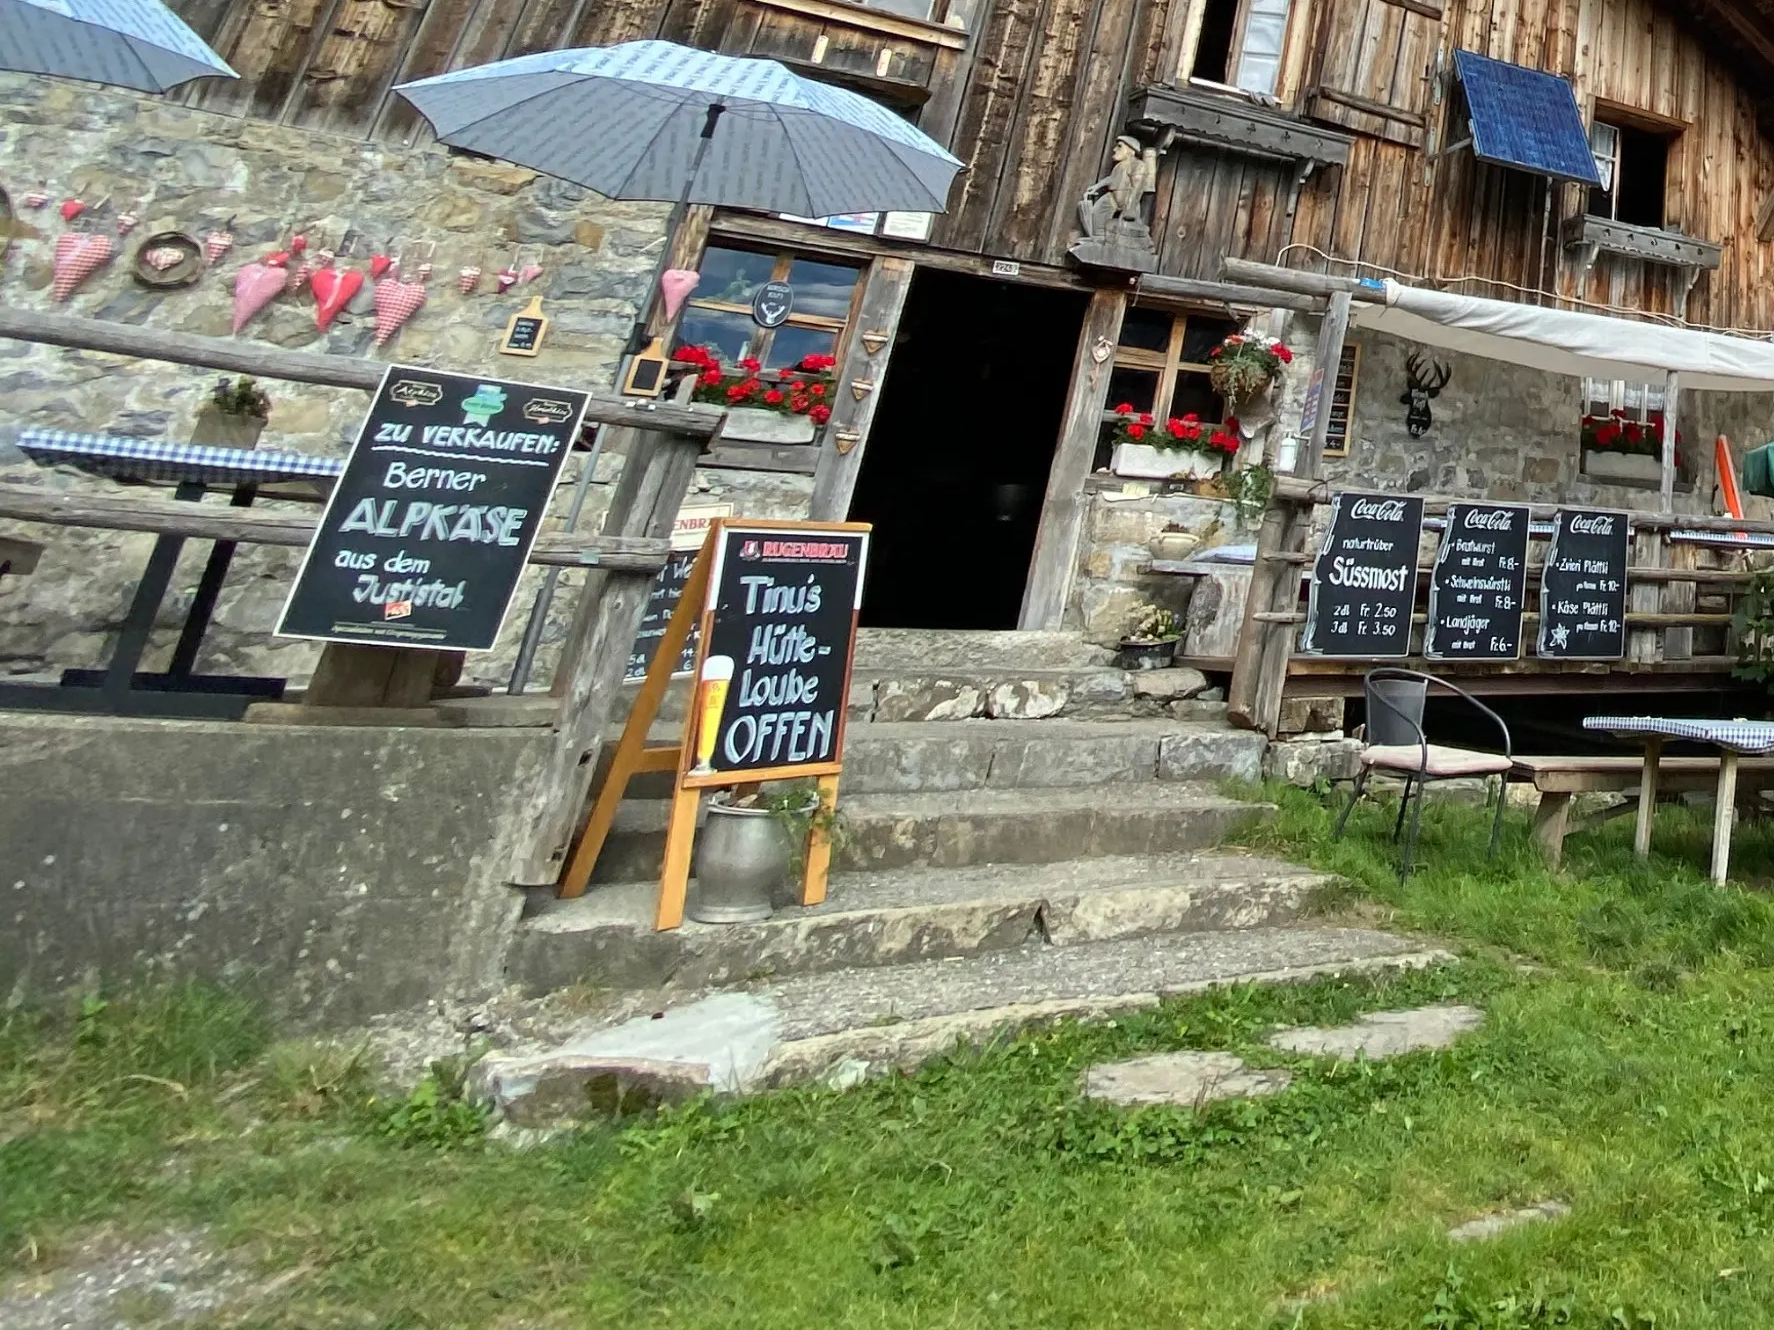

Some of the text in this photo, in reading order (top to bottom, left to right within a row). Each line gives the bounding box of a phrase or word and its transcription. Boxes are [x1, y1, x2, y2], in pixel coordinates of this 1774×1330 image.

[374, 423, 561, 454] ZU VERKAUFEN:
[383, 462, 486, 491] Berner
[338, 497, 528, 547] ALPKÄSE
[1342, 537, 1394, 552] naturtrüber
[1456, 538, 1495, 555] Bratwurst
[334, 549, 431, 574] aus dem
[1328, 555, 1408, 592] Süssmost
[1374, 602, 1397, 618] 2.50
[1557, 600, 1579, 615] Käse
[1372, 621, 1396, 637] 3.50
[1446, 614, 1491, 636] Landjäger
[747, 623, 832, 665] Hütte-
[738, 668, 819, 708] Loube
[724, 709, 835, 764] OFFEN
